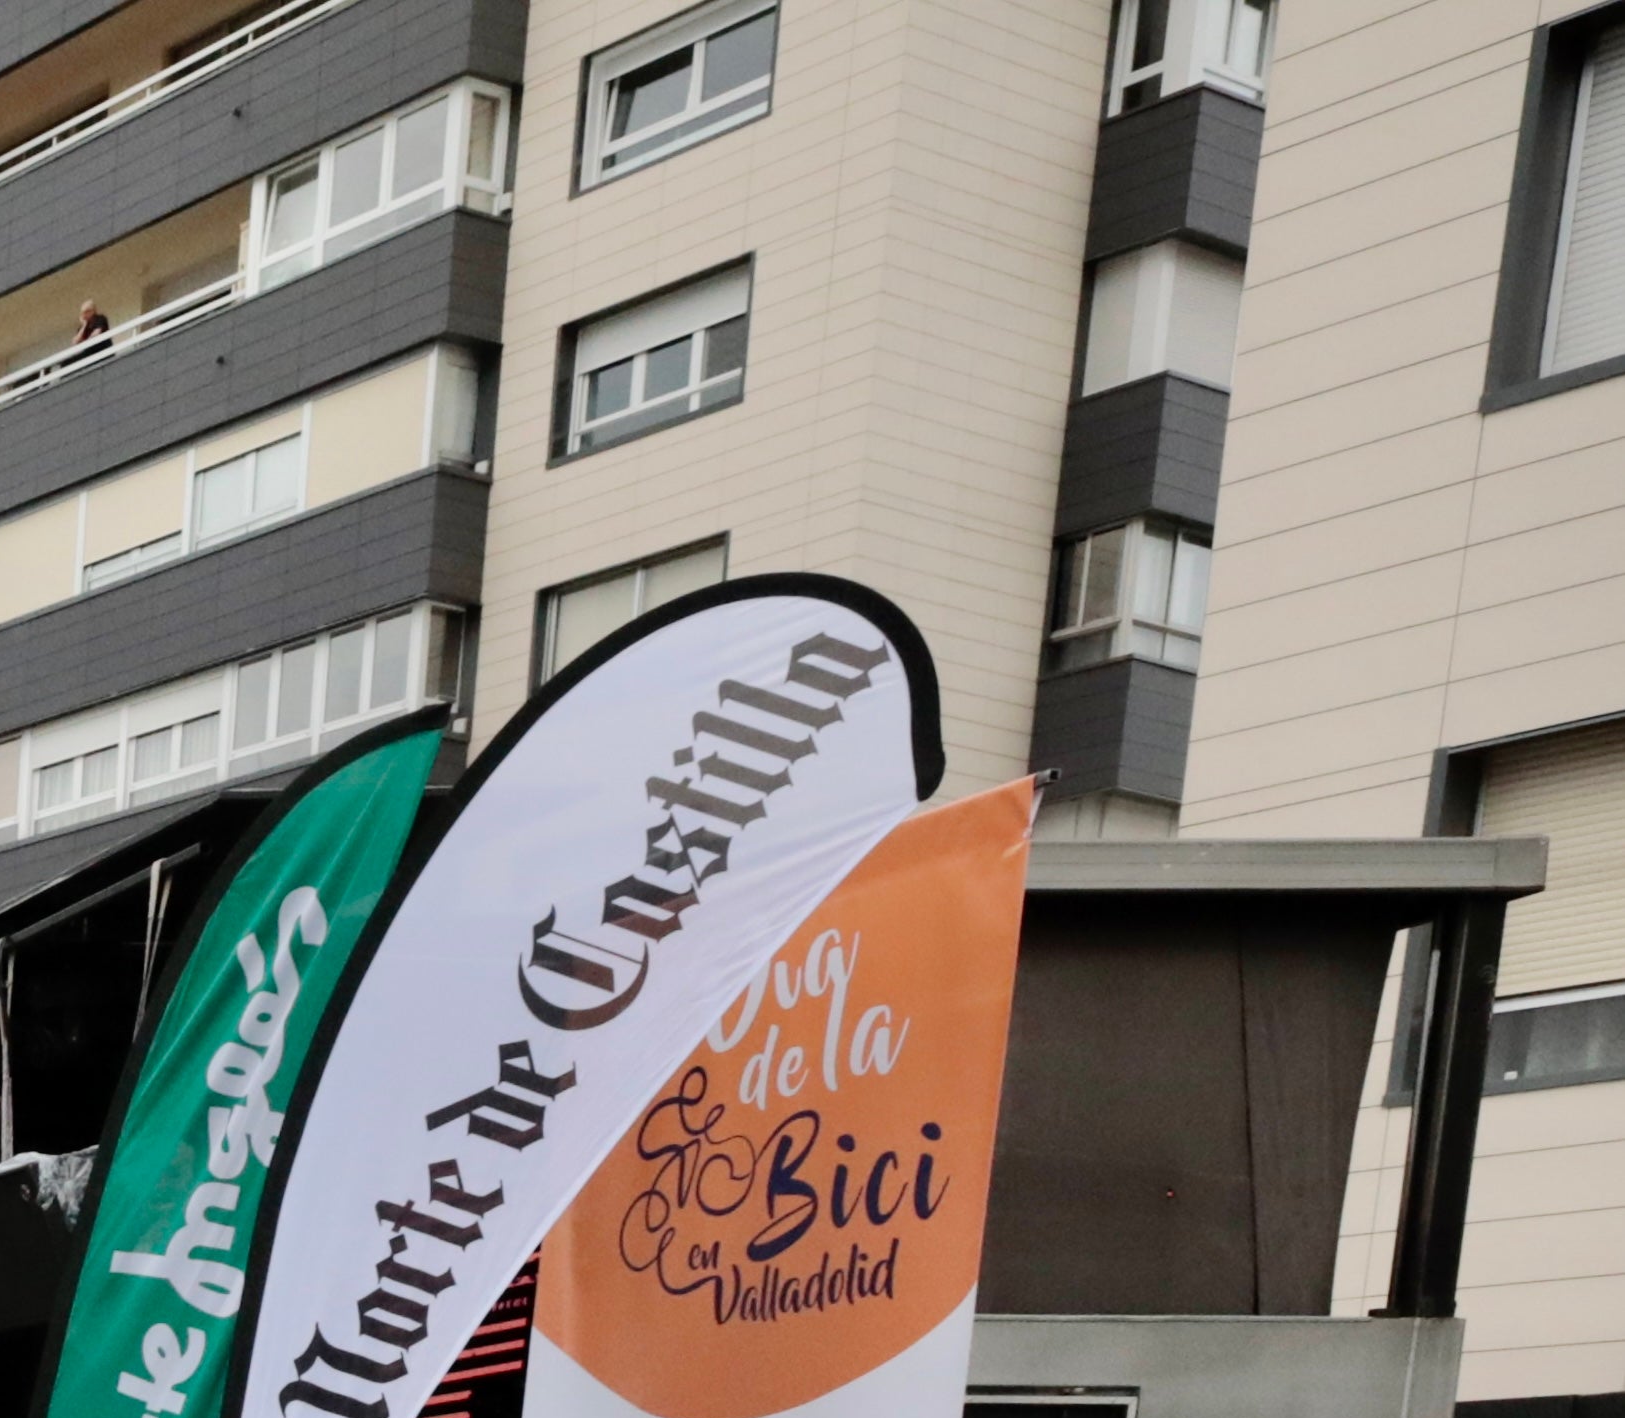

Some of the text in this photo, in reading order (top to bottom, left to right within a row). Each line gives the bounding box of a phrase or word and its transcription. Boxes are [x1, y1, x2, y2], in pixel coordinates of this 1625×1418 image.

[425, 1040, 578, 1151] de
[518, 631, 890, 1031] Castilla
[110, 885, 328, 1319] Inglés
[738, 992, 911, 1111] de la
[747, 1109, 949, 1263] Bici
[704, 1238, 897, 1326] Valladolid
